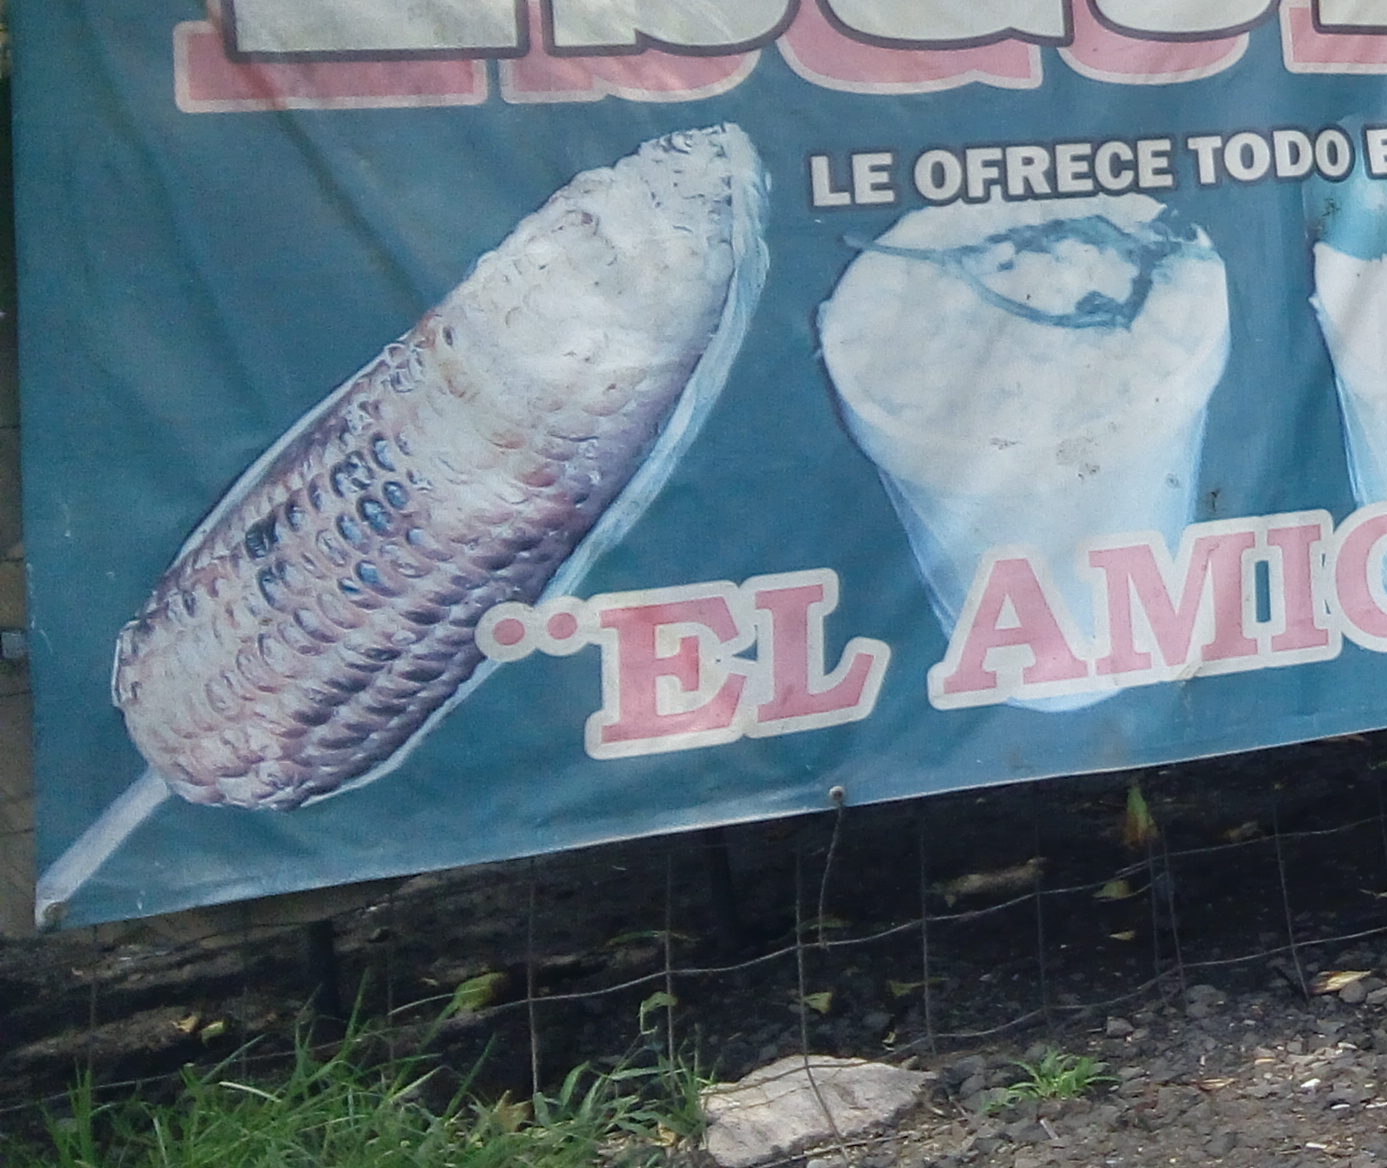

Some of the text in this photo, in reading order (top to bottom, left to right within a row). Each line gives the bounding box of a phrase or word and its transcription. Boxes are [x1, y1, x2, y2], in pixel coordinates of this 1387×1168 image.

[808, 151, 898, 208] LE
[912, 137, 1175, 203] OFRECE
[1187, 127, 1352, 186] TODO
